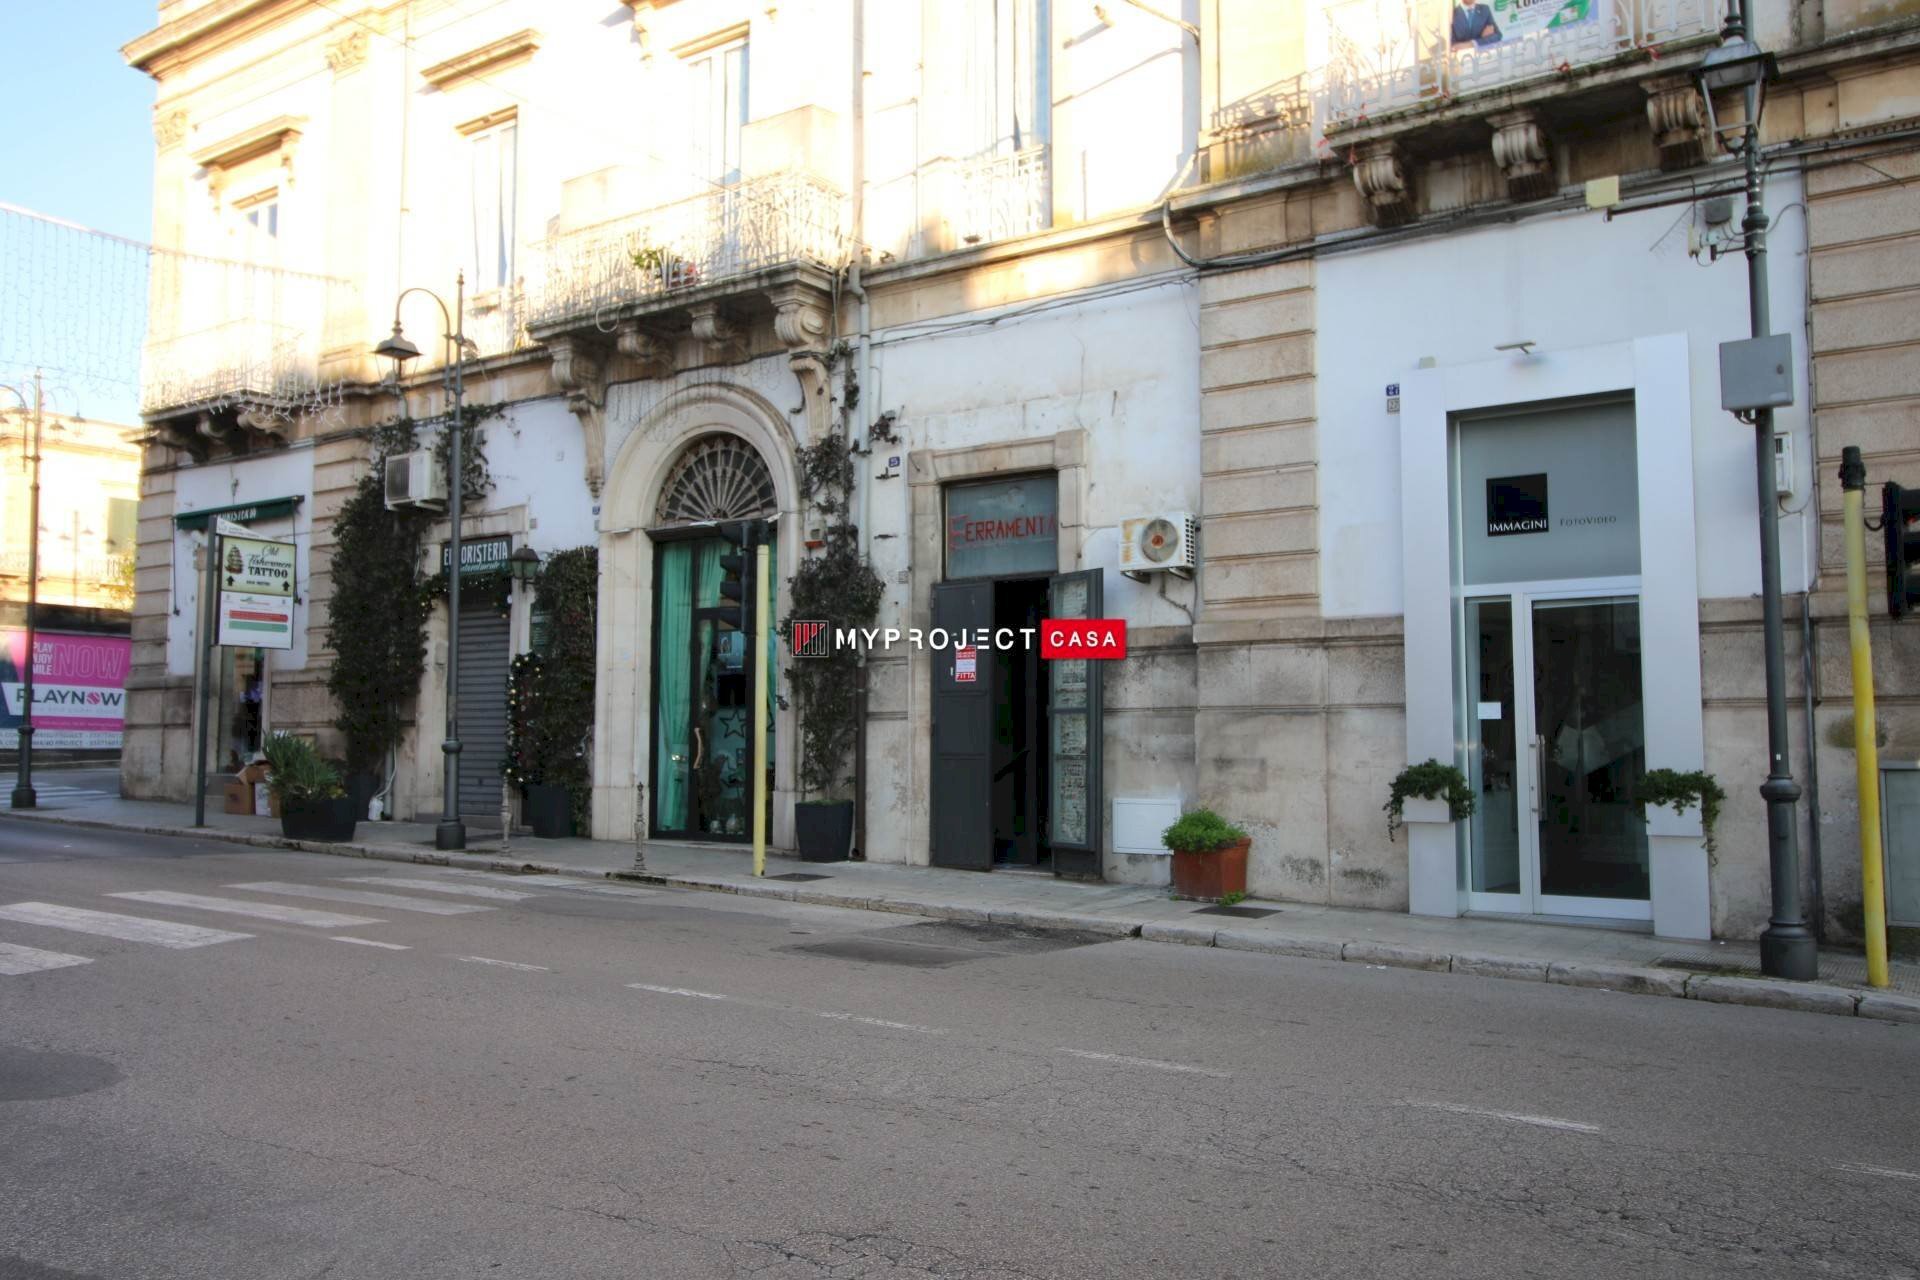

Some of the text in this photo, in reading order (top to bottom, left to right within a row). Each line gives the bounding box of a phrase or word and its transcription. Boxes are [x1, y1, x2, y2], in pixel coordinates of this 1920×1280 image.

[1489, 519, 1547, 532] IMMAGINI
[443, 541, 508, 566] EORISTERIA
[248, 566, 288, 578] TATTOO
[53, 643, 125, 679] NOW
